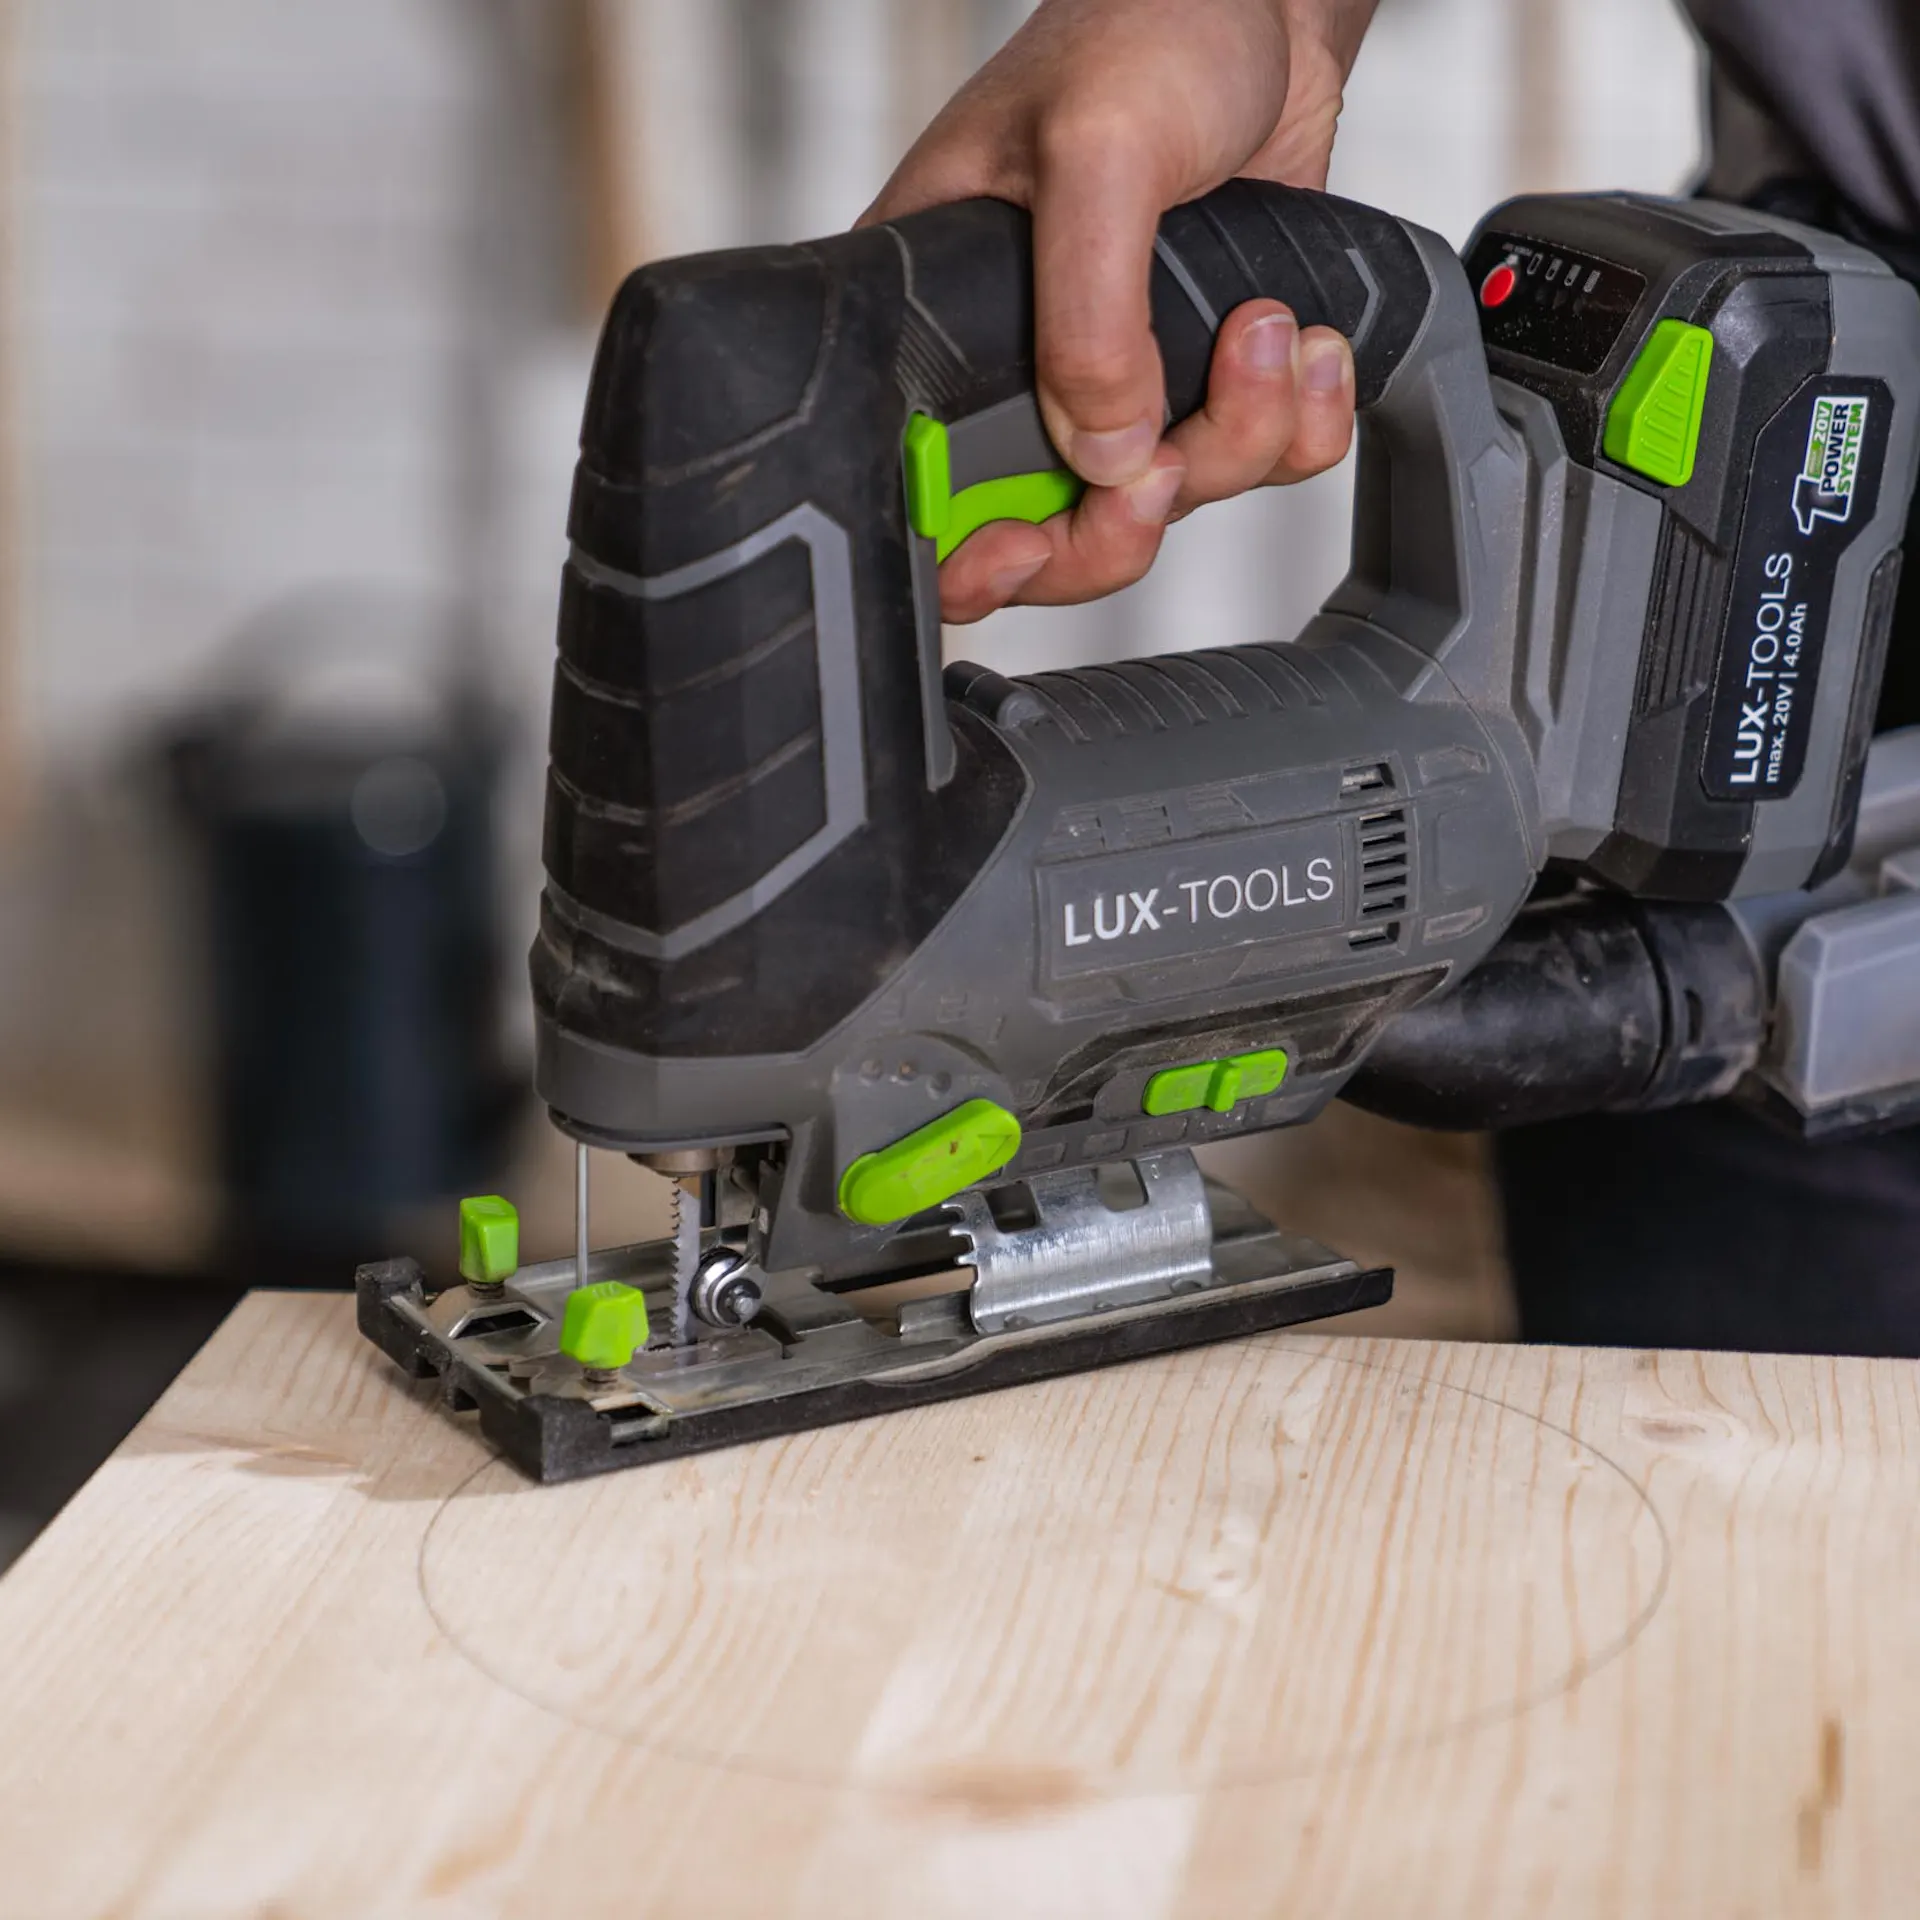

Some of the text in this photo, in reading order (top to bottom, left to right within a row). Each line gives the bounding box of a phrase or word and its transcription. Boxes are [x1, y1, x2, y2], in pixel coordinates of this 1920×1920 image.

[1814, 404, 1831, 442] 20V
[1821, 403, 1849, 493] POWER
[1837, 402, 1864, 493] SYSTEM
[1729, 552, 1794, 784] LUX-TOOLS
[1783, 602, 1808, 668] 4.0Ah
[1773, 683, 1795, 727] 20V
[1766, 729, 1787, 783] max.
[1064, 857, 1335, 947] LUX-TOOLS
